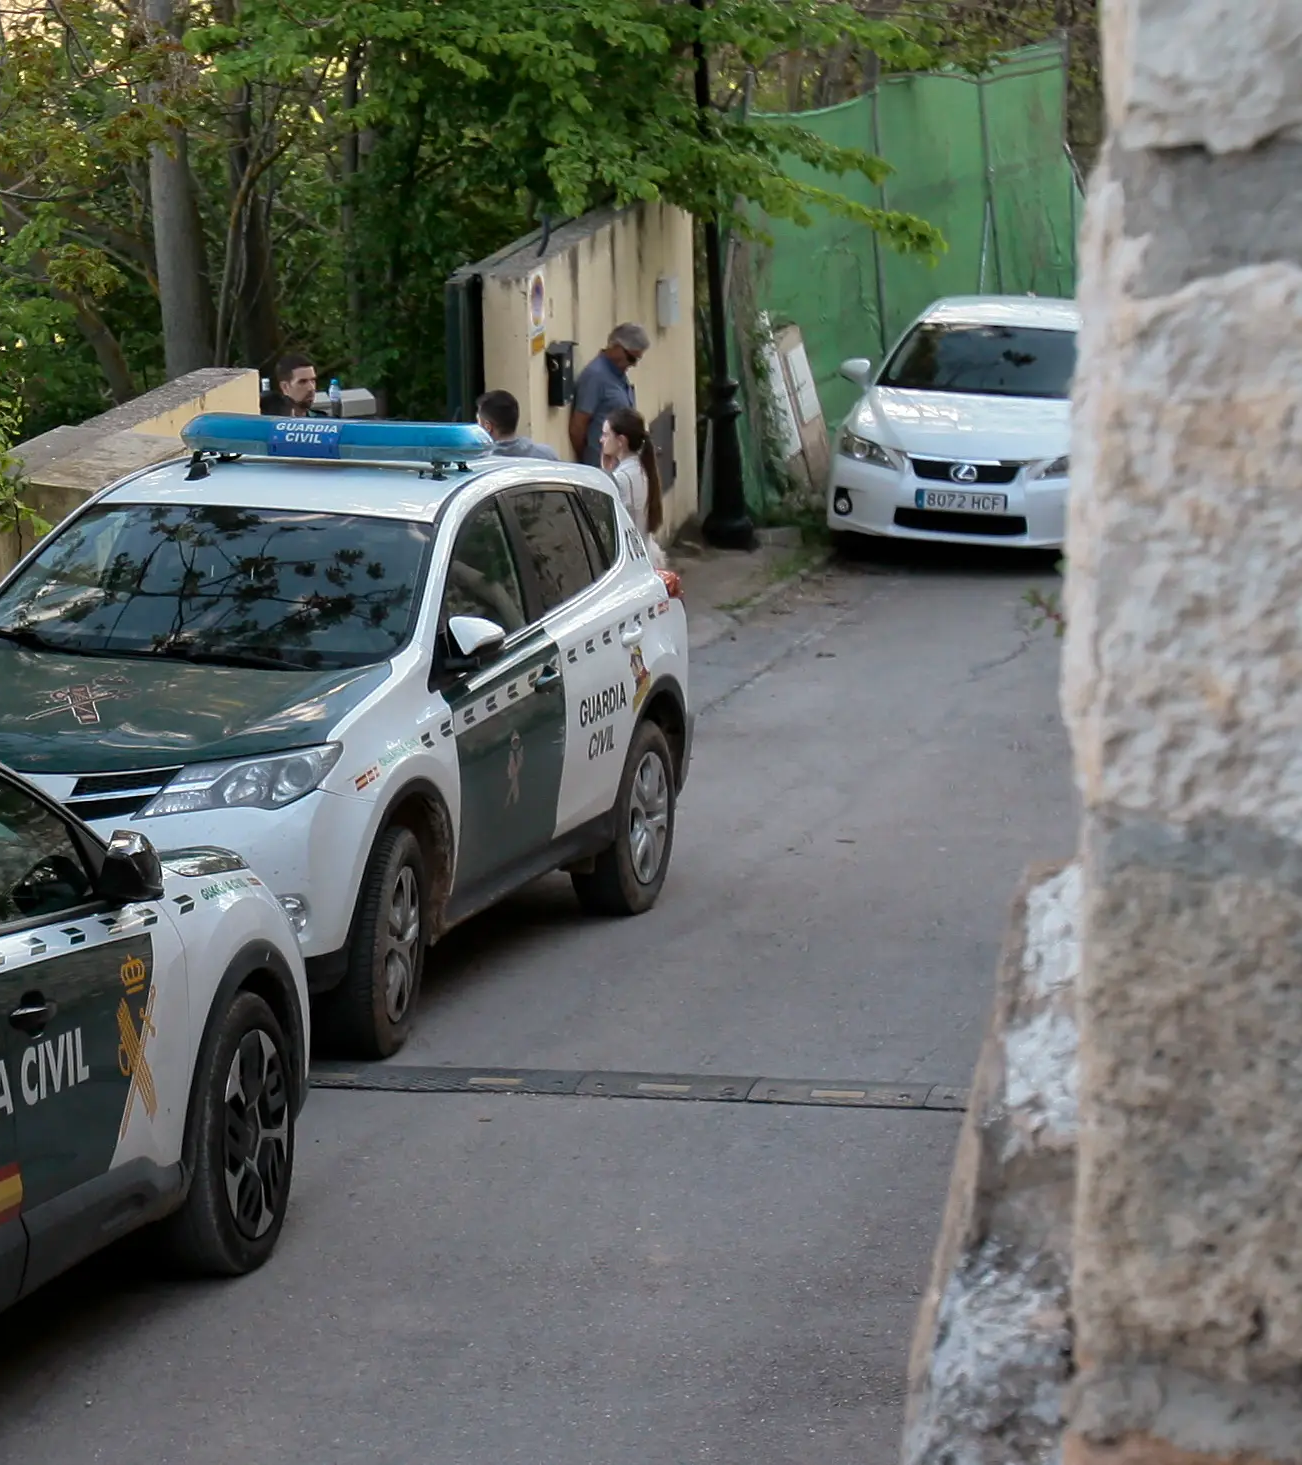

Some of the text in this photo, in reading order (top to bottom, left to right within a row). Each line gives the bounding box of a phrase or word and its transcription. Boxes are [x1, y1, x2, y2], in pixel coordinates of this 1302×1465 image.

[276, 422, 338, 434] GUARDIA
[285, 432, 322, 444] CIVIL
[927, 492, 1002, 511] 8072 HCF
[579, 681, 627, 729] GUARDIA
[588, 724, 615, 761] CIVIL
[20, 1027, 90, 1106] CIVIL
